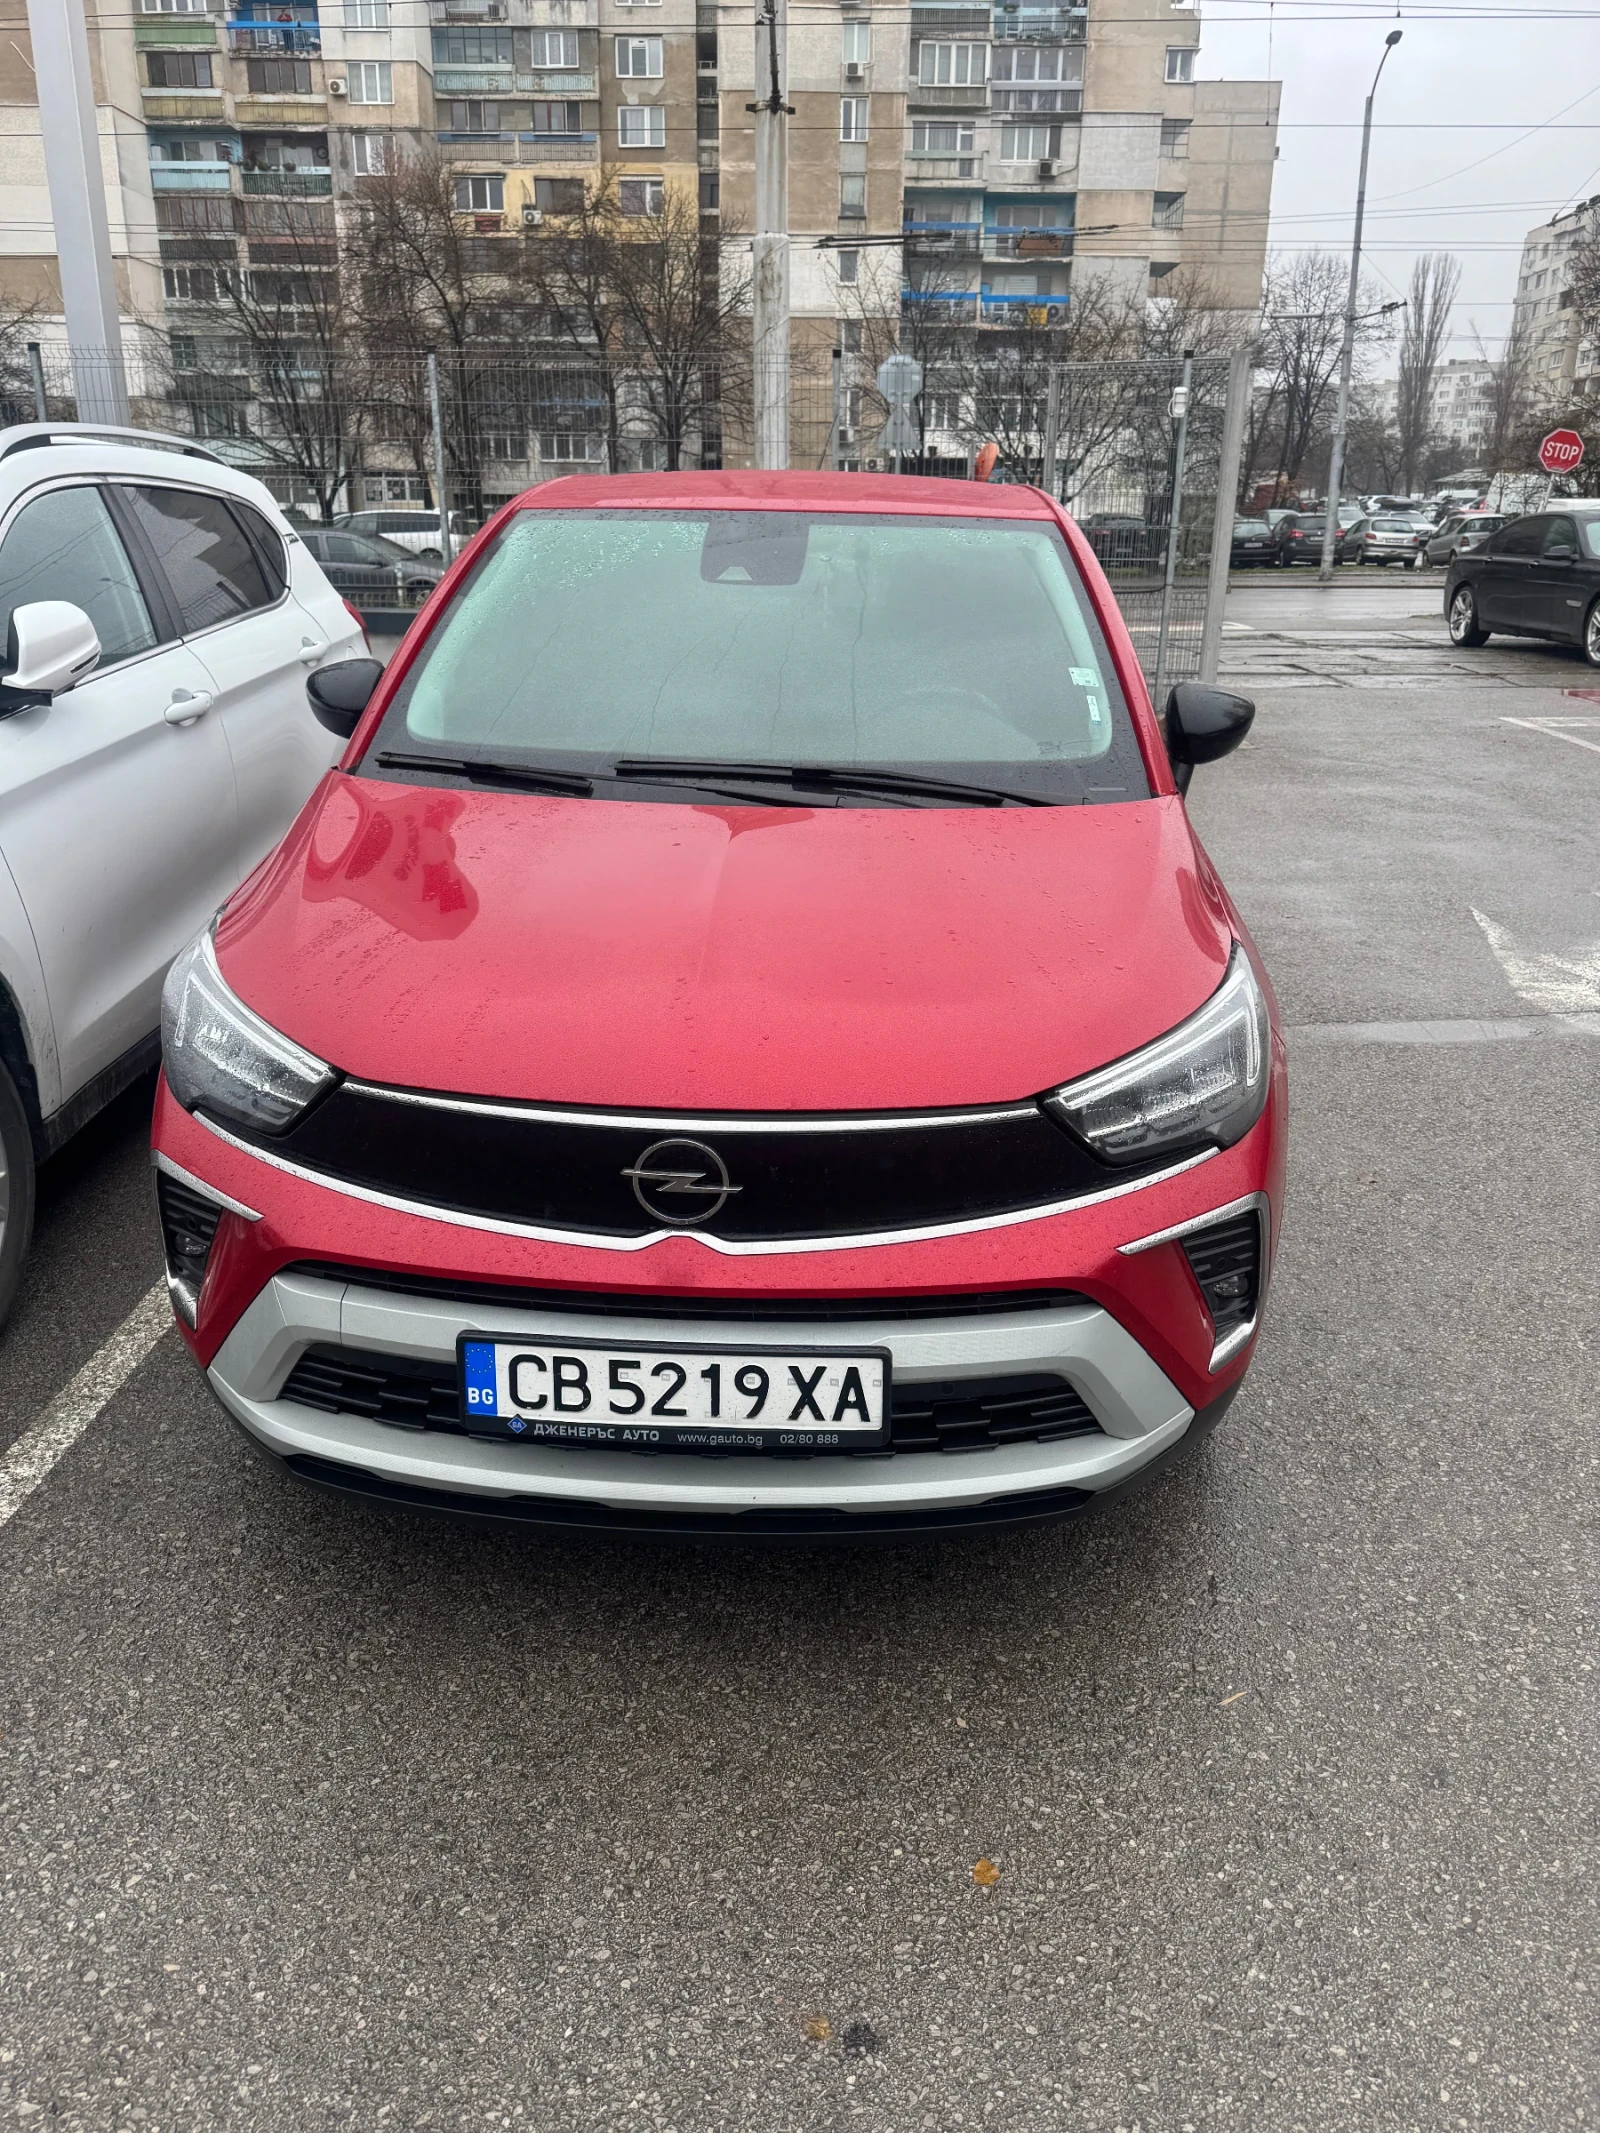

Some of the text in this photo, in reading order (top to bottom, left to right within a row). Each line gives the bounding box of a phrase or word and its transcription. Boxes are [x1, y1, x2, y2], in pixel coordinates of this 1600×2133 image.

[1544, 441, 1579, 461] STOP
[508, 1353, 871, 1422] CB 5219 XA
[467, 1387, 494, 1405] BG
[622, 1429, 660, 1442] АУТО
[677, 1434, 763, 1446] www.gauto.bg
[816, 1434, 839, 1444] 888
